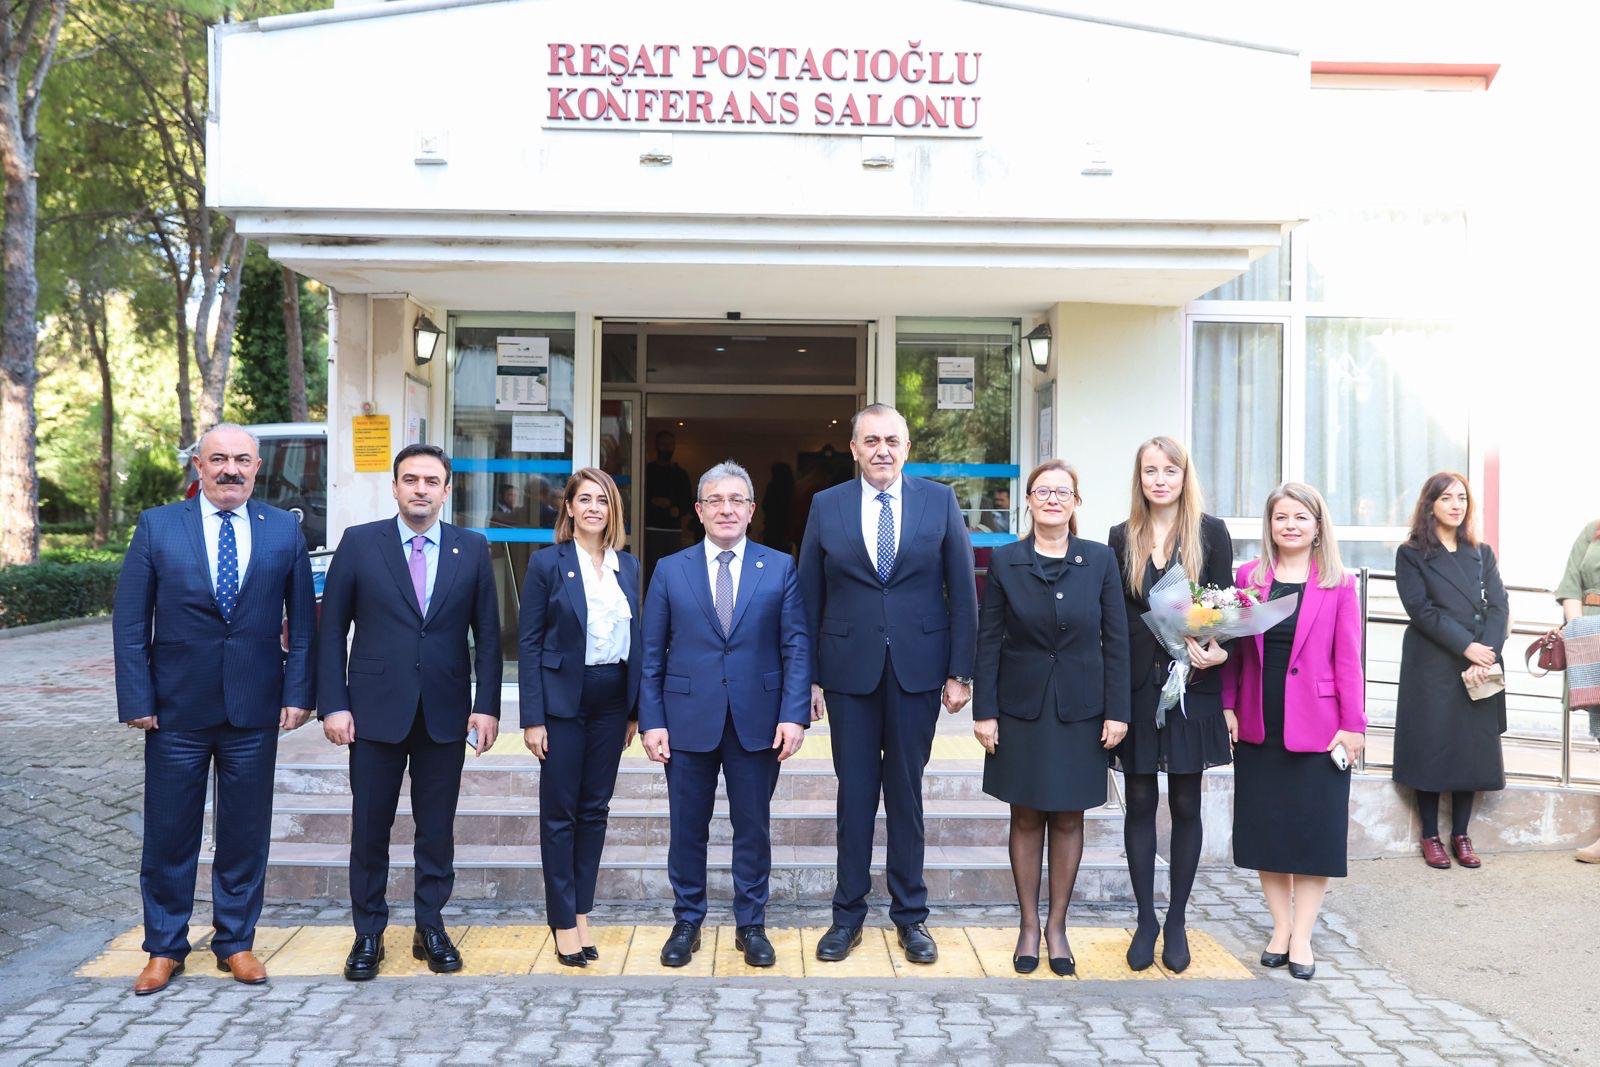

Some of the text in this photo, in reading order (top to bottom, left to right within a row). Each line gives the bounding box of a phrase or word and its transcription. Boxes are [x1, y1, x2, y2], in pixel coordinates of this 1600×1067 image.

[547, 40, 982, 86] REŞAT POSTACIOĞLU
[546, 87, 982, 128] KONFERANS SALONU
